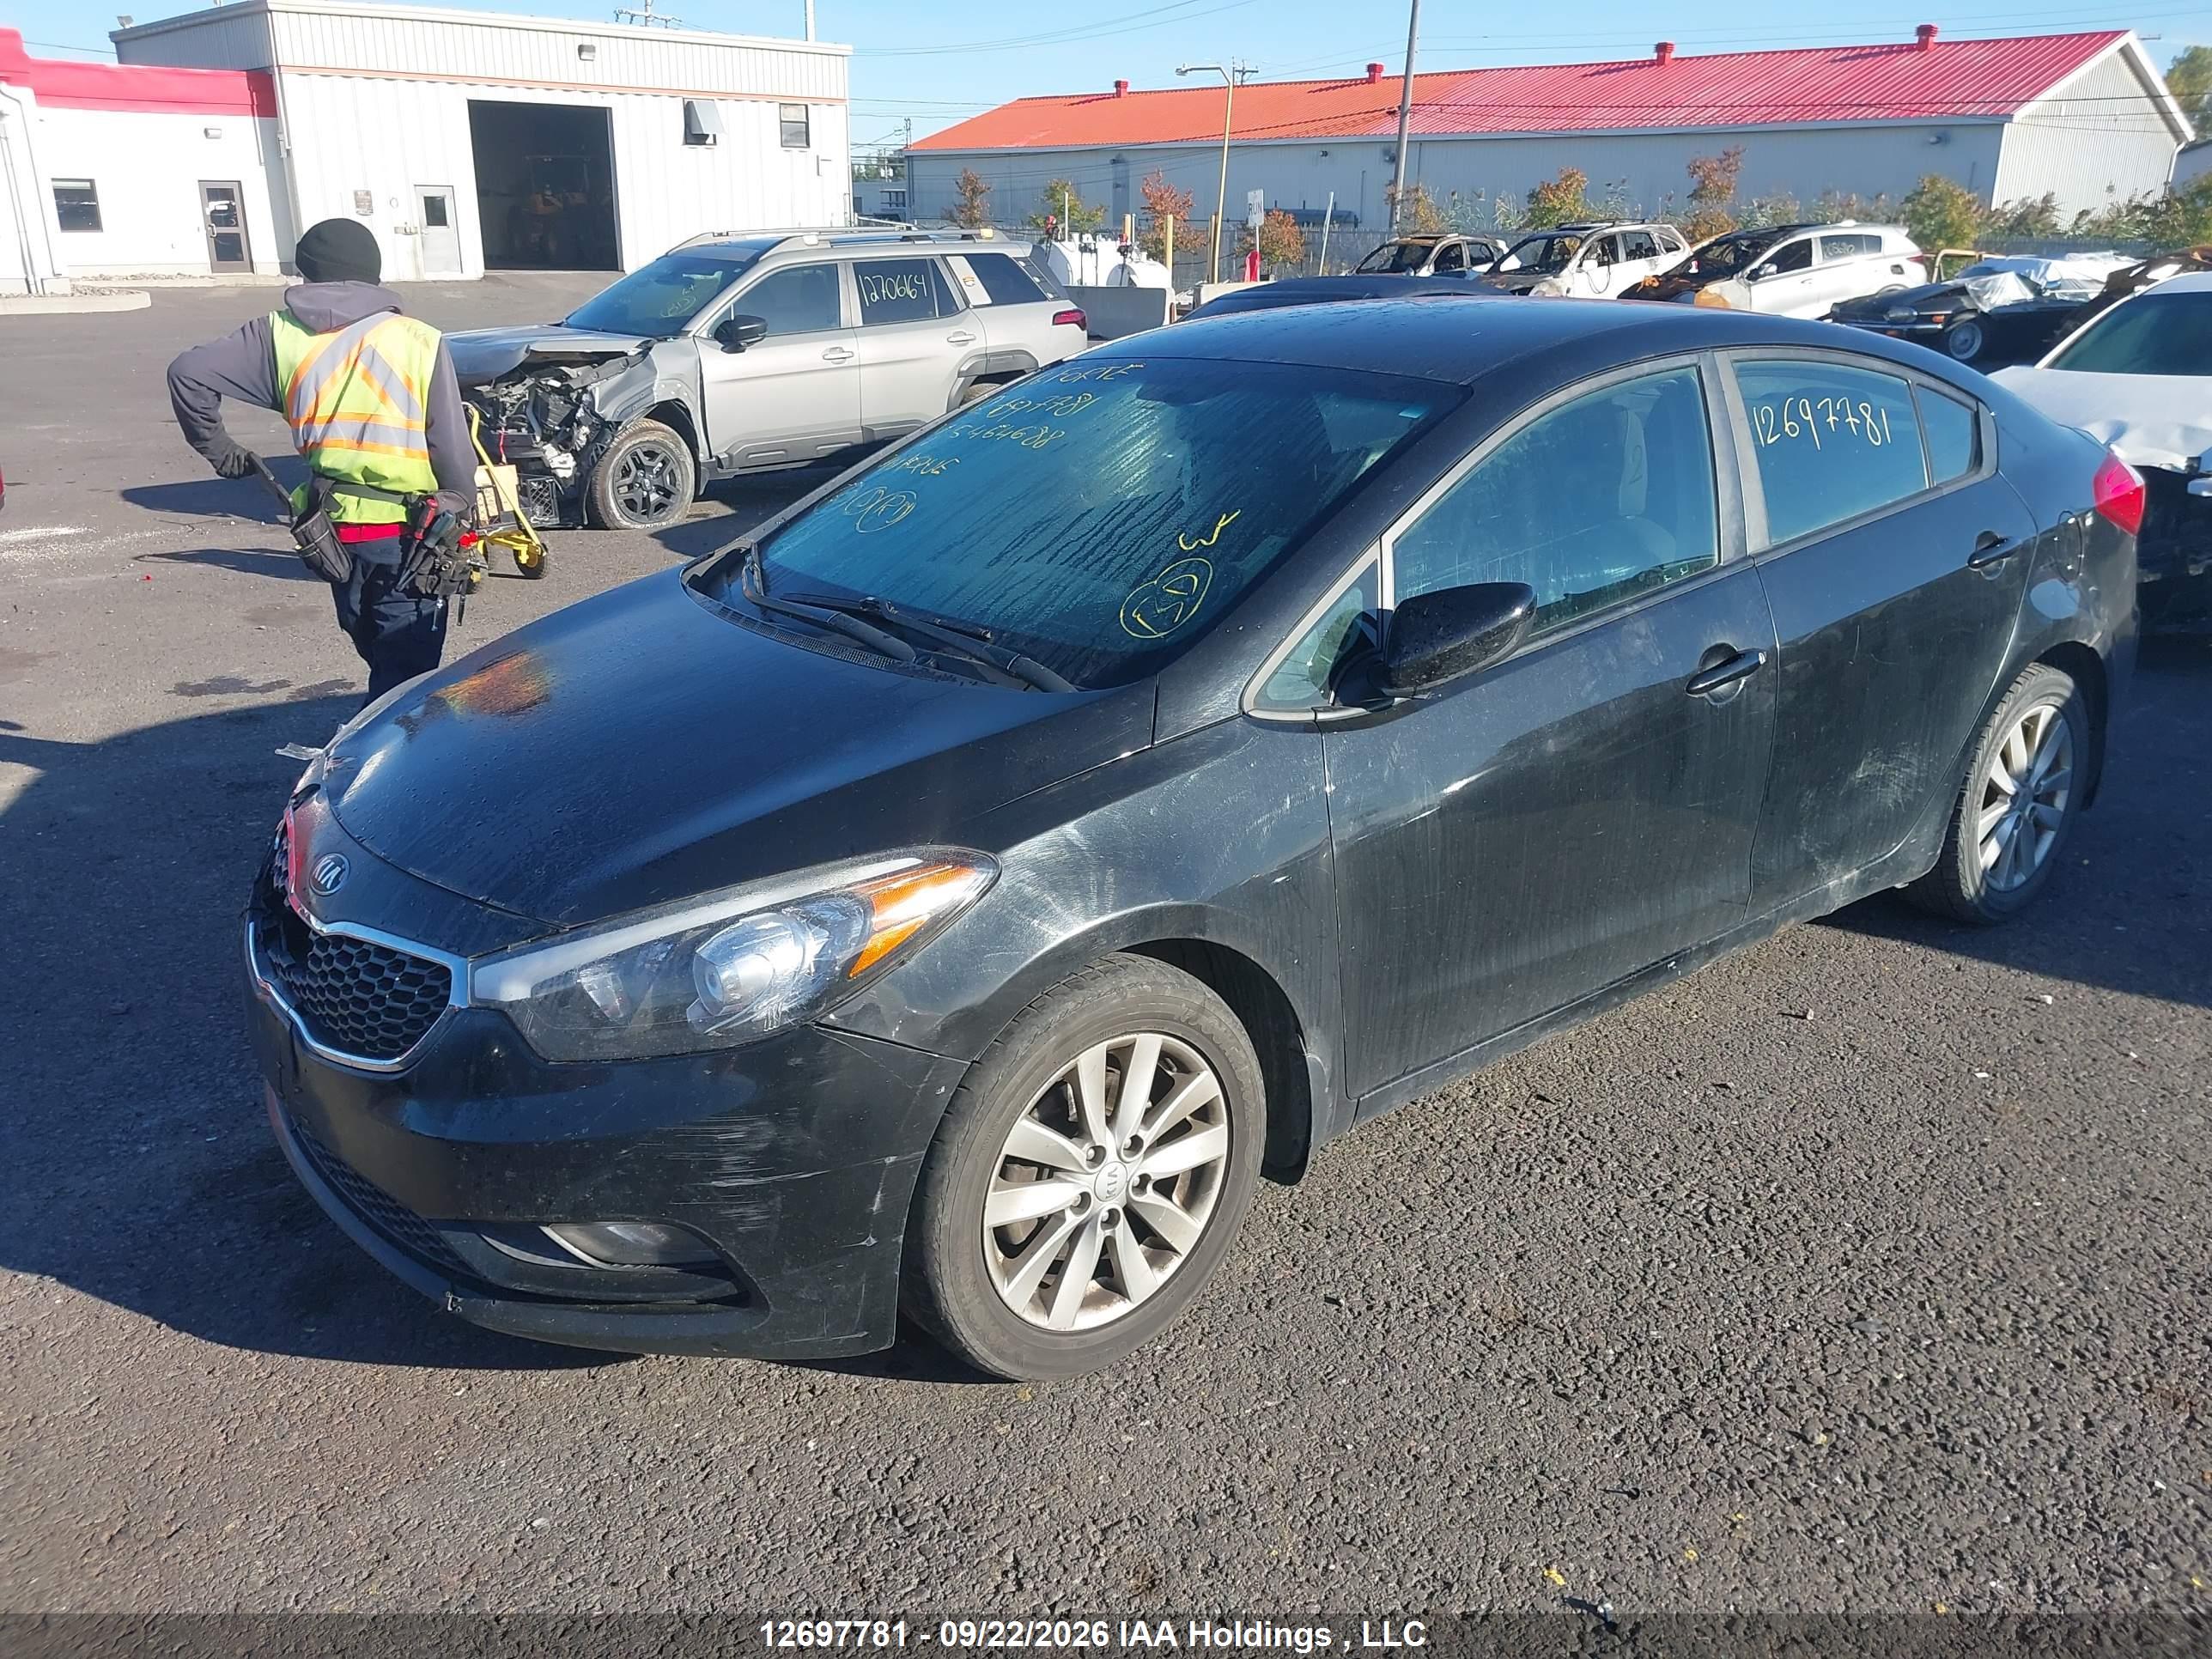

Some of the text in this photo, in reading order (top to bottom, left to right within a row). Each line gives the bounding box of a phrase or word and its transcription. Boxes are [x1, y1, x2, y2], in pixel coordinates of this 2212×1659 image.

[1248, 200, 1263, 216] RUN
[1043, 363, 1146, 384] FORTE
[1753, 396, 1892, 452] 12697781
[313, 856, 342, 890] KIA
